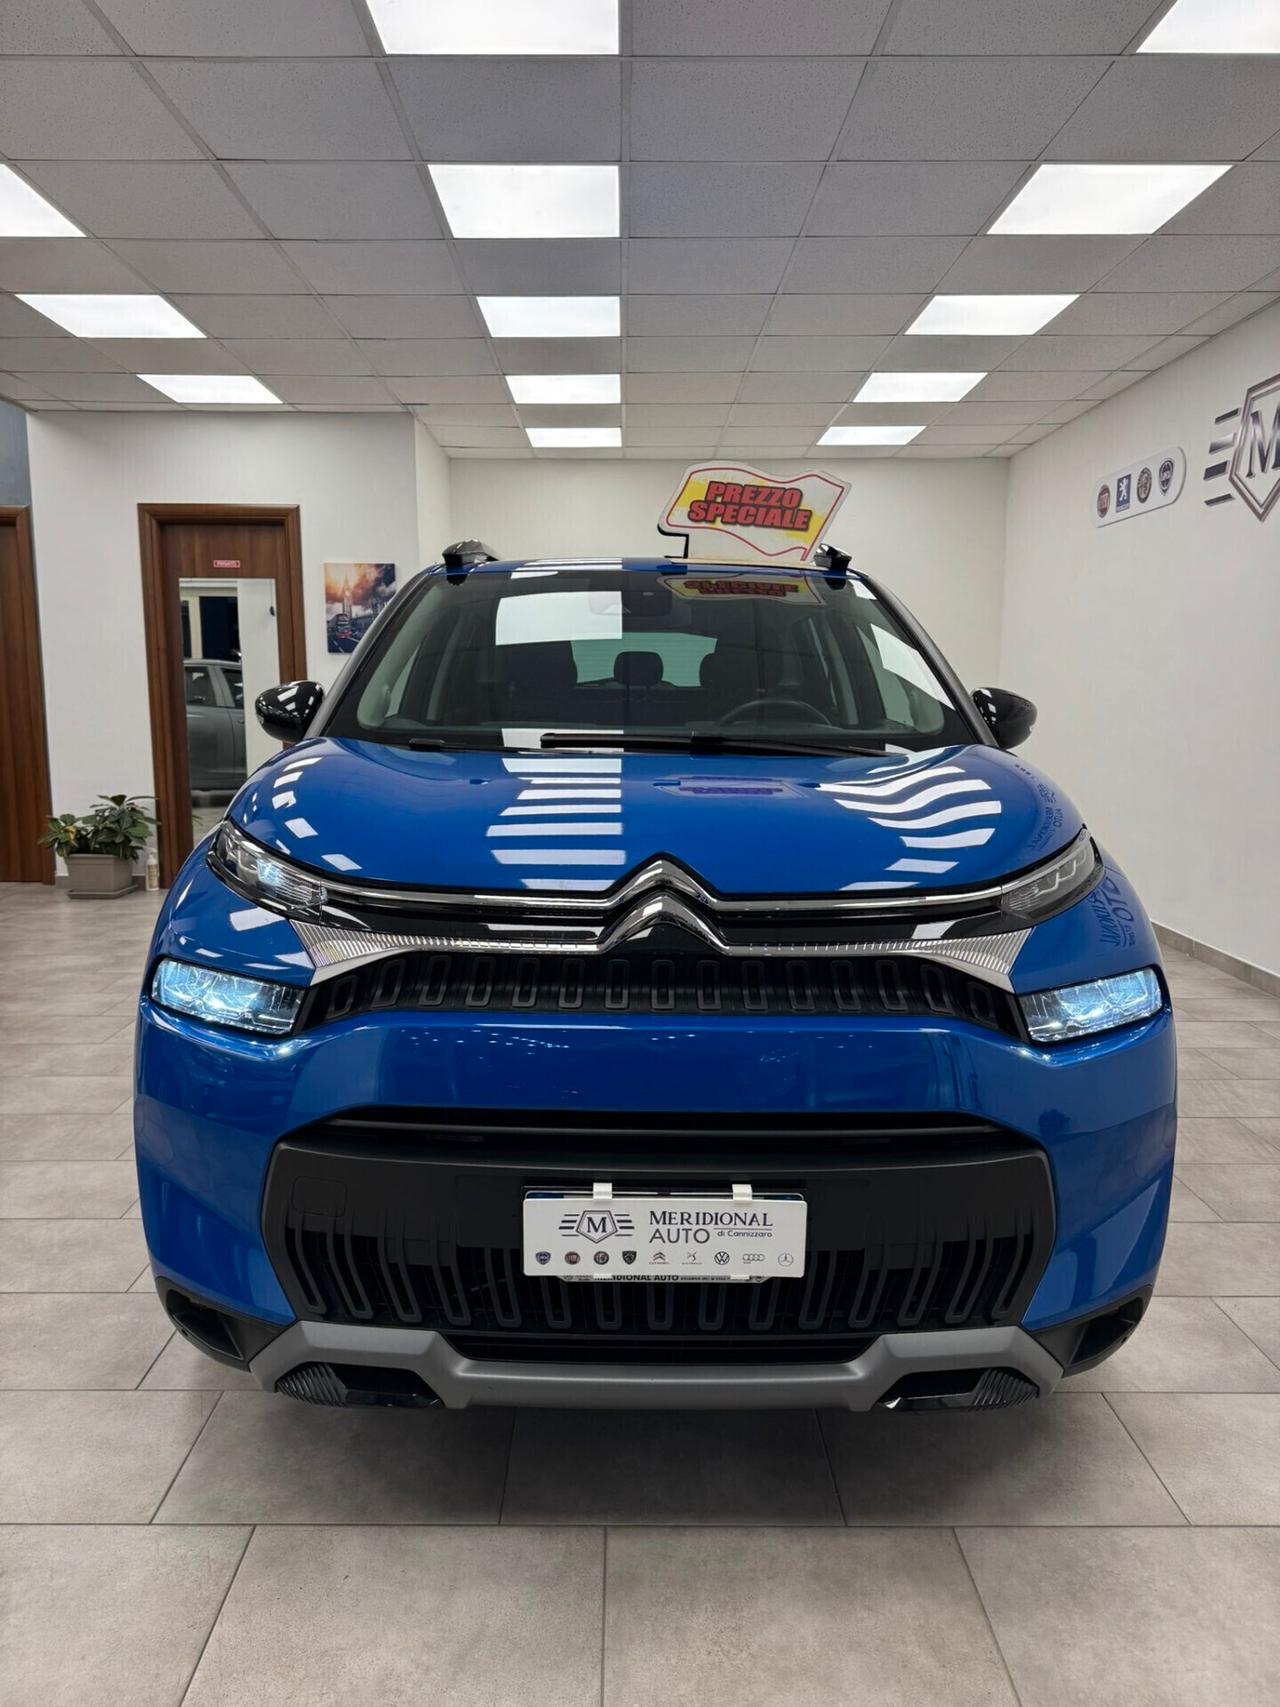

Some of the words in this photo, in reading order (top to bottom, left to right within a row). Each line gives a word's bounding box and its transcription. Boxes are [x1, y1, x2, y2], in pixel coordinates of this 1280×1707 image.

[705, 481, 803, 509] PREZZO
[688, 500, 812, 531] SPECIALE
[587, 1216, 607, 1233] M
[649, 1211, 773, 1226] MERIDIONAL
[649, 1228, 710, 1244] AUTO
[727, 1230, 773, 1238] Cannizzaro
